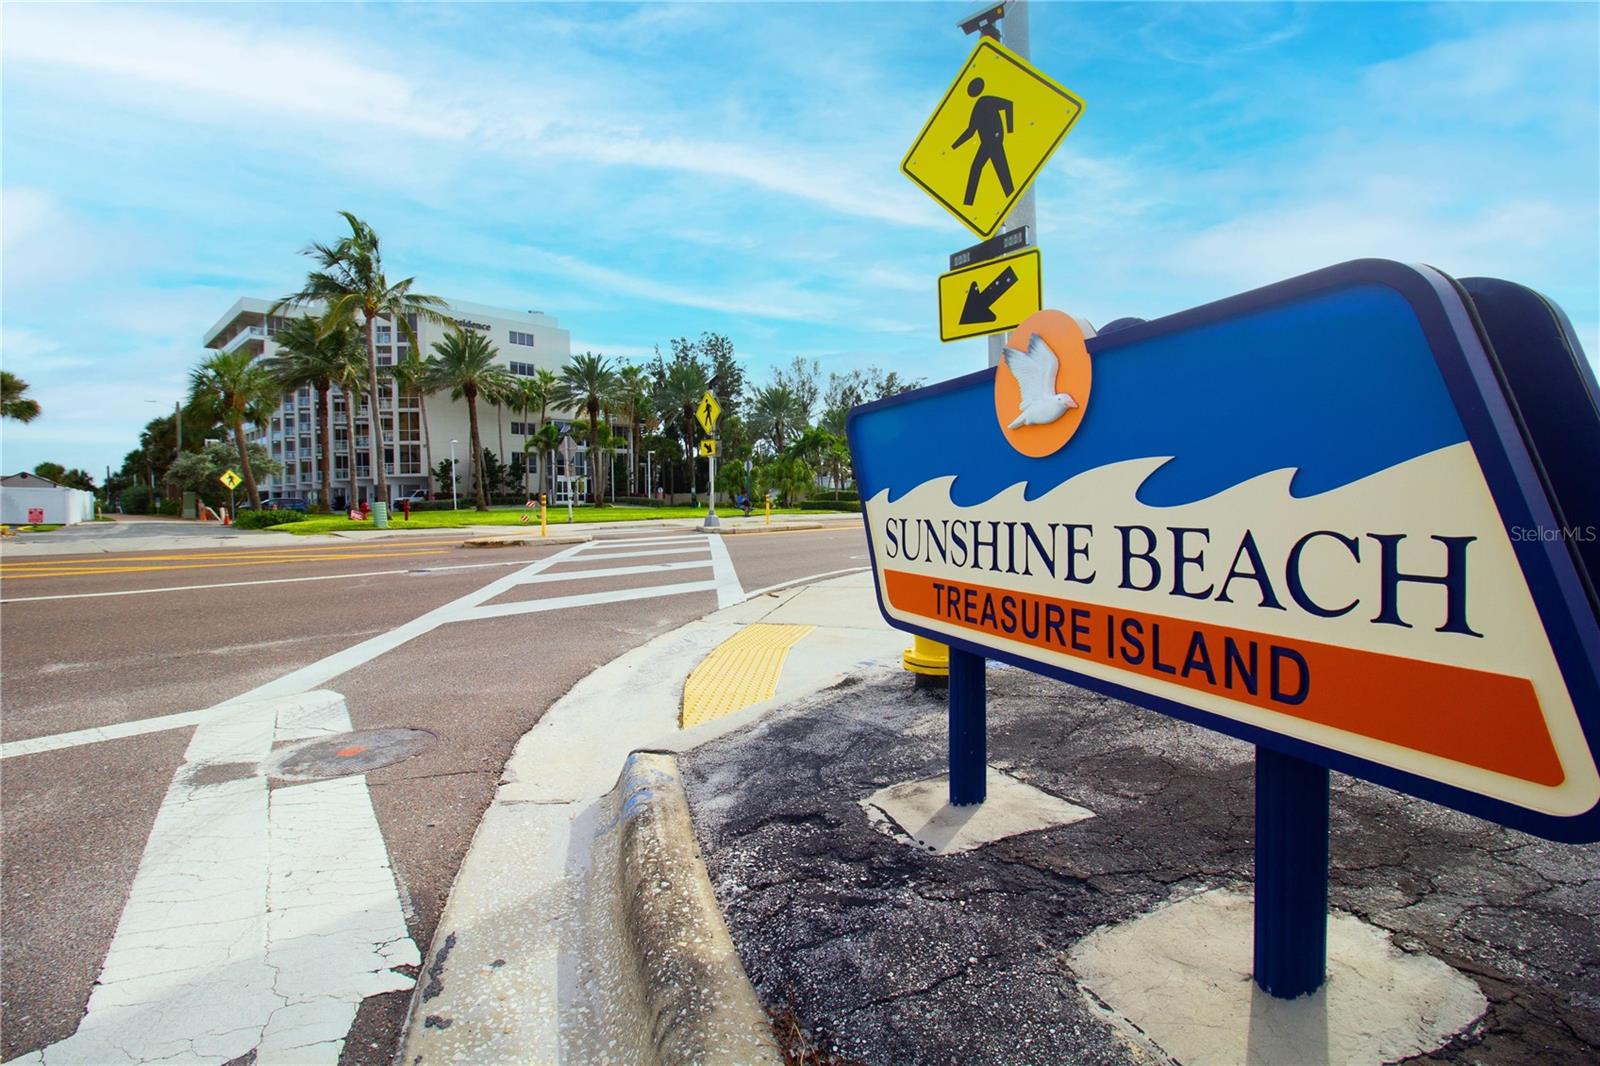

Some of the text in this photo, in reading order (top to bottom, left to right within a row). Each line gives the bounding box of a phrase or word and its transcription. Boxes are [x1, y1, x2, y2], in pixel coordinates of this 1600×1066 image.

[885, 517, 1484, 639] SUNSHINE BEACH
[932, 582, 1311, 706] TREASURE ISLAND
